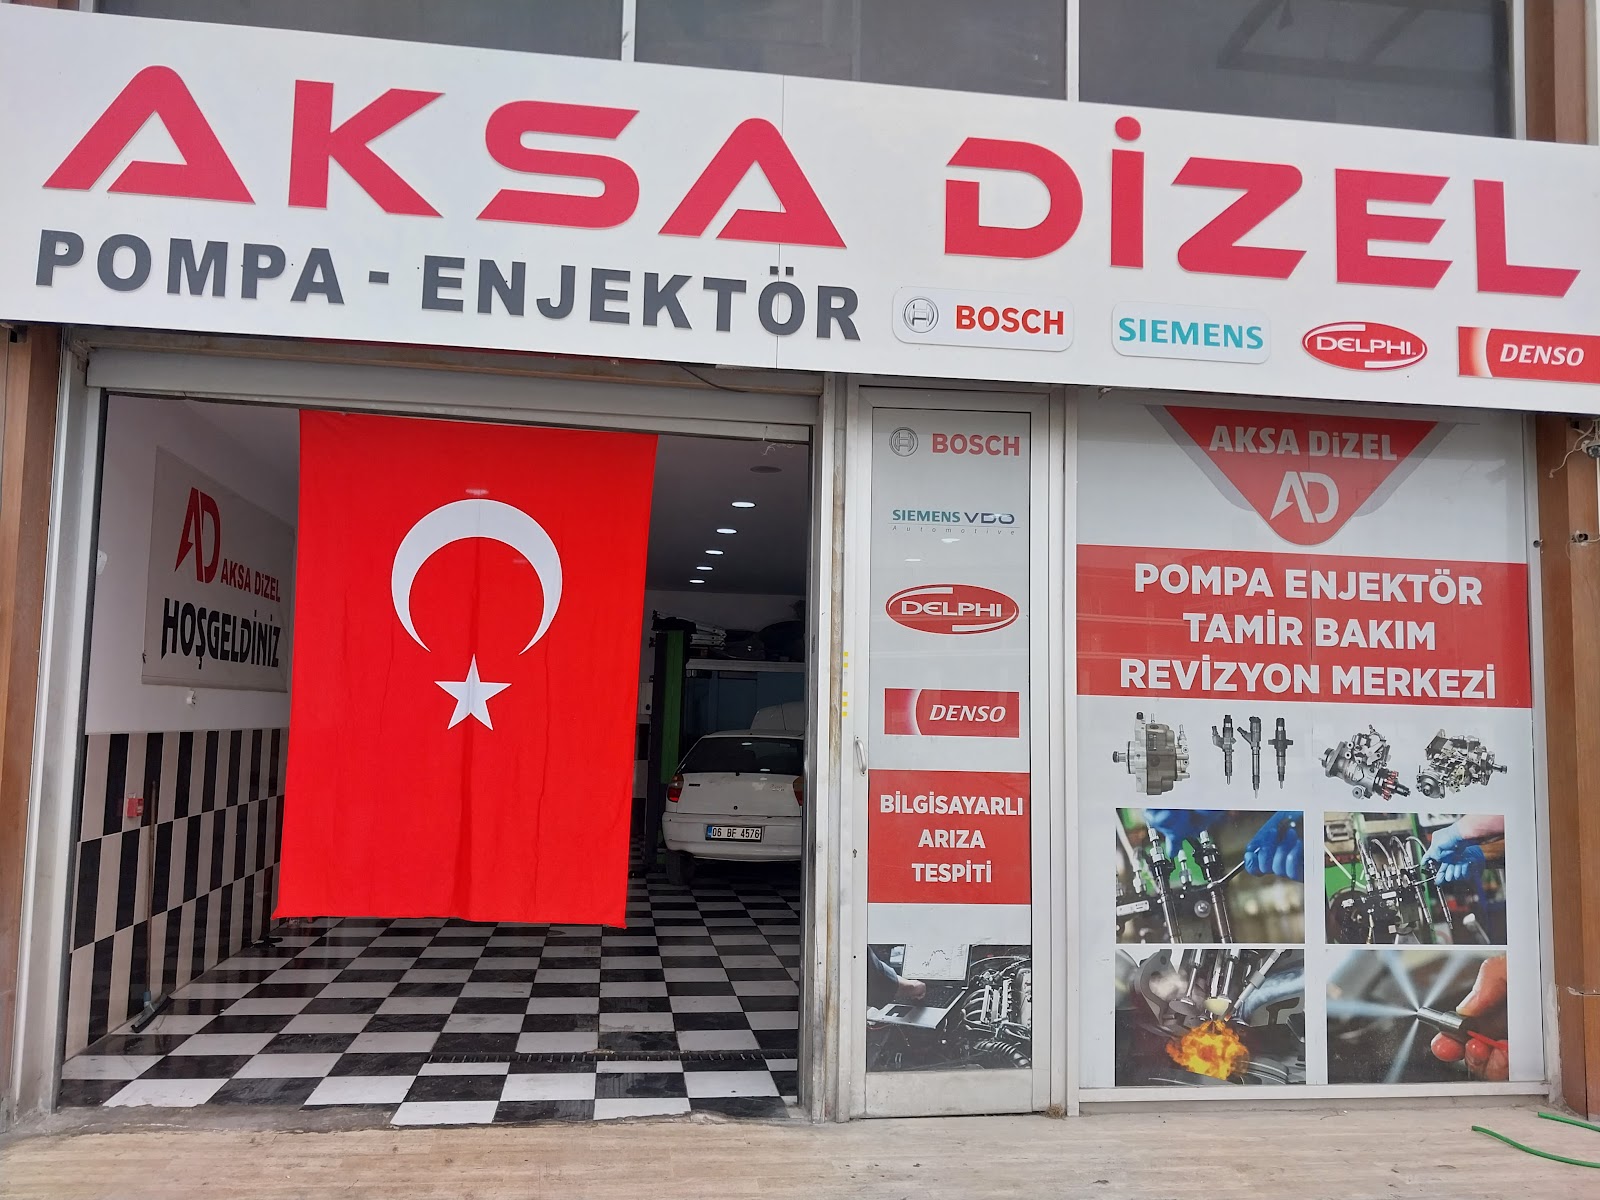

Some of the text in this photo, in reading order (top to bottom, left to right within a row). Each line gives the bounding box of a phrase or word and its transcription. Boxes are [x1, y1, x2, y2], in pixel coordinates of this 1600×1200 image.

[43, 66, 1580, 298] AKSA DİZEL
[35, 229, 345, 305] POMPA
[422, 255, 861, 341] ENJEKTÖR
[955, 305, 1065, 336] BOSCH
[1118, 317, 1264, 351] SIEMENS
[1316, 336, 1411, 355] DELPHI
[1499, 343, 1585, 368] DENSO
[932, 433, 1020, 456] BOSCH
[1209, 425, 1299, 455] AKSA
[892, 509, 1015, 524] SIEMENS VDO
[892, 525, 1015, 536] Automotive
[220, 558, 251, 593] AKSA
[1135, 563, 1274, 598] POMPA
[1285, 568, 1483, 606] ENJEKTÖR
[901, 600, 1002, 617] DELPHI
[161, 598, 281, 670] HOŞGELDİNİZ
[1183, 609, 1436, 651] TAMİR BAKIM
[1120, 655, 1496, 699] REVİZYON MERKEZİ
[929, 705, 1006, 723] DENSO
[880, 790, 1023, 816] BİLGİSAYARLI
[712, 827, 760, 839] 06 BF 4576
[918, 829, 986, 849] ARIZA
[911, 860, 992, 883] TESPİTİ
